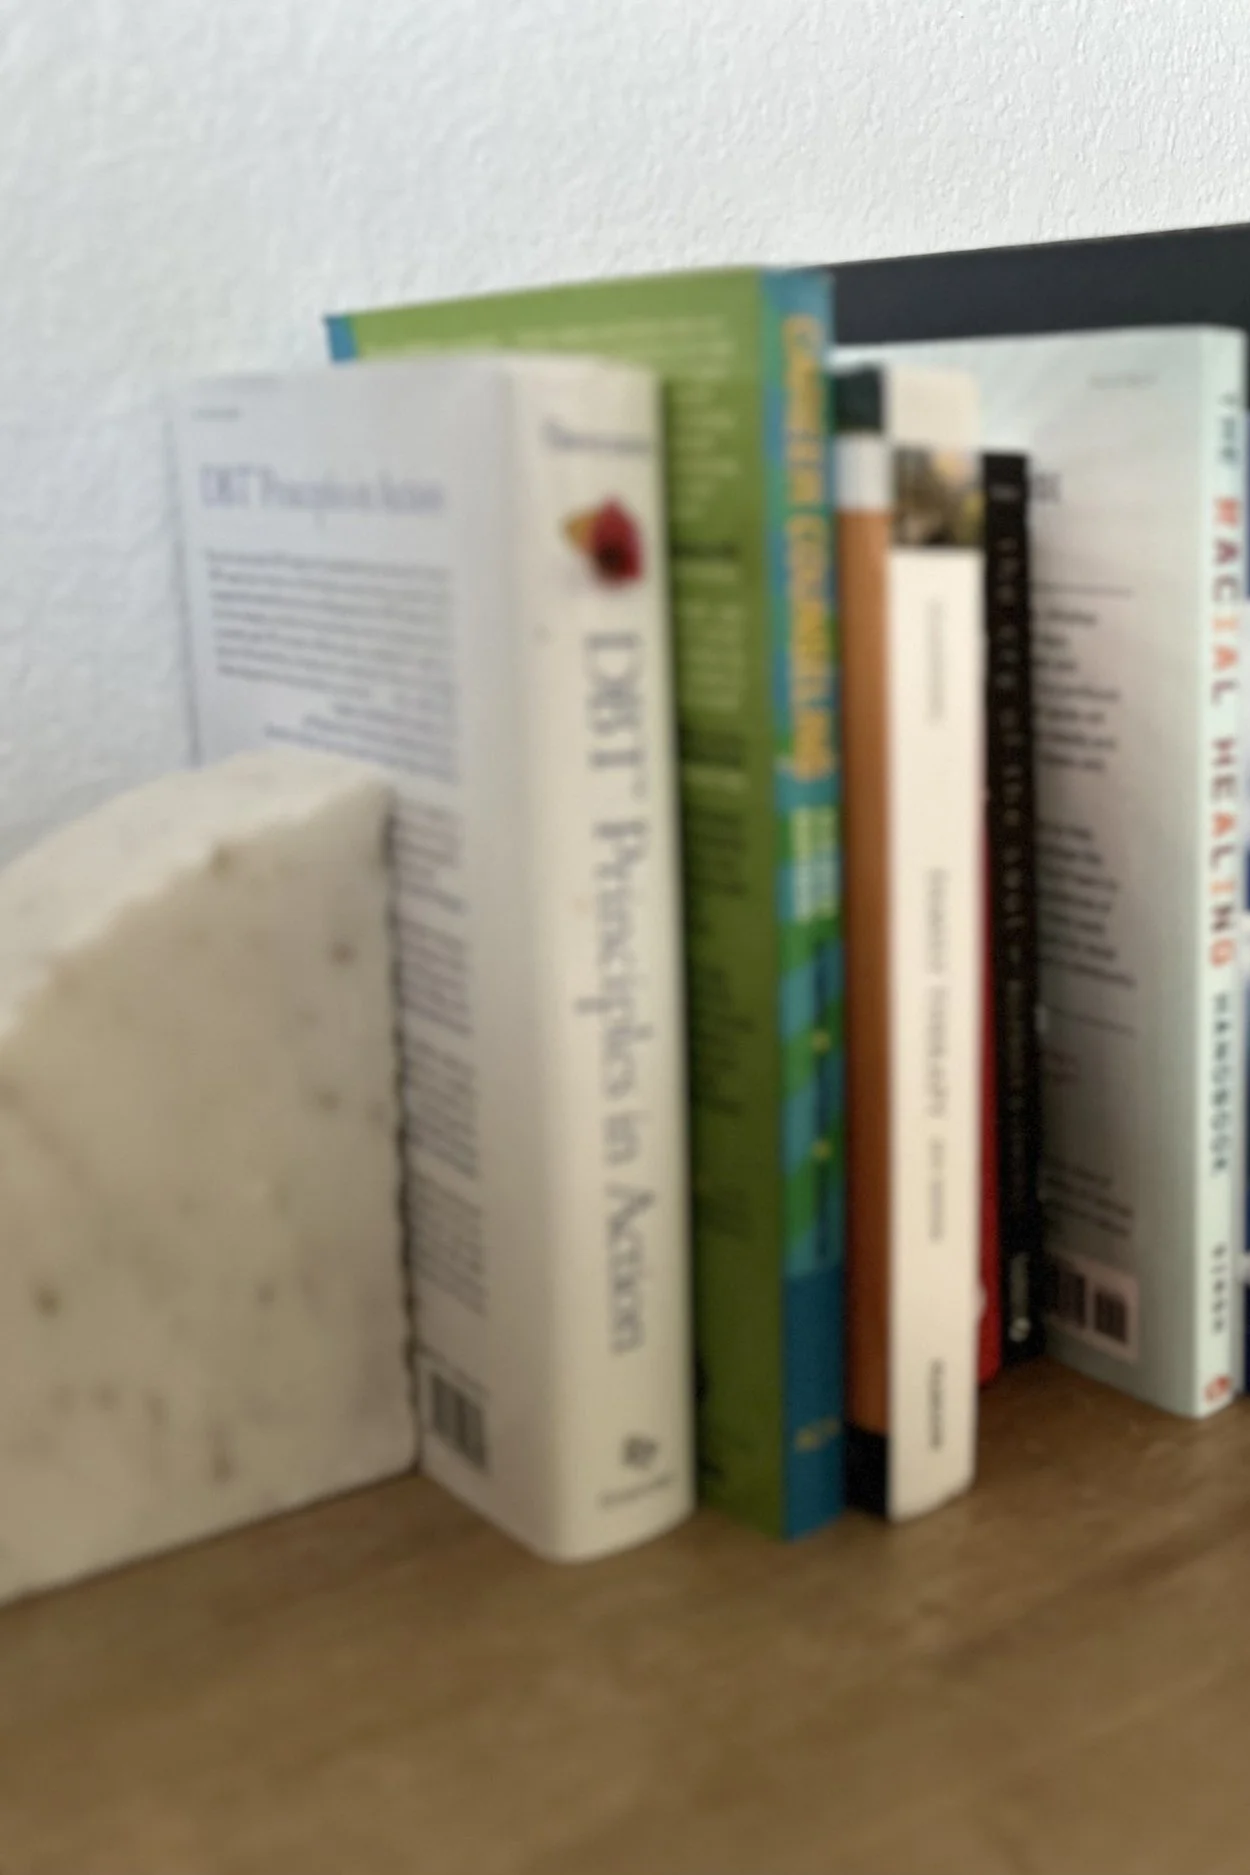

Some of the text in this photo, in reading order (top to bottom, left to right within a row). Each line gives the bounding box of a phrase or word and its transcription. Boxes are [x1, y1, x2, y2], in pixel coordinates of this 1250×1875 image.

[1210, 496, 1241, 705] RACIAL
[1207, 736, 1239, 967] HEALING
[574, 820, 654, 1100] Principles
[1210, 992, 1235, 1179] HANDBOOK
[603, 1182, 657, 1354] Action
